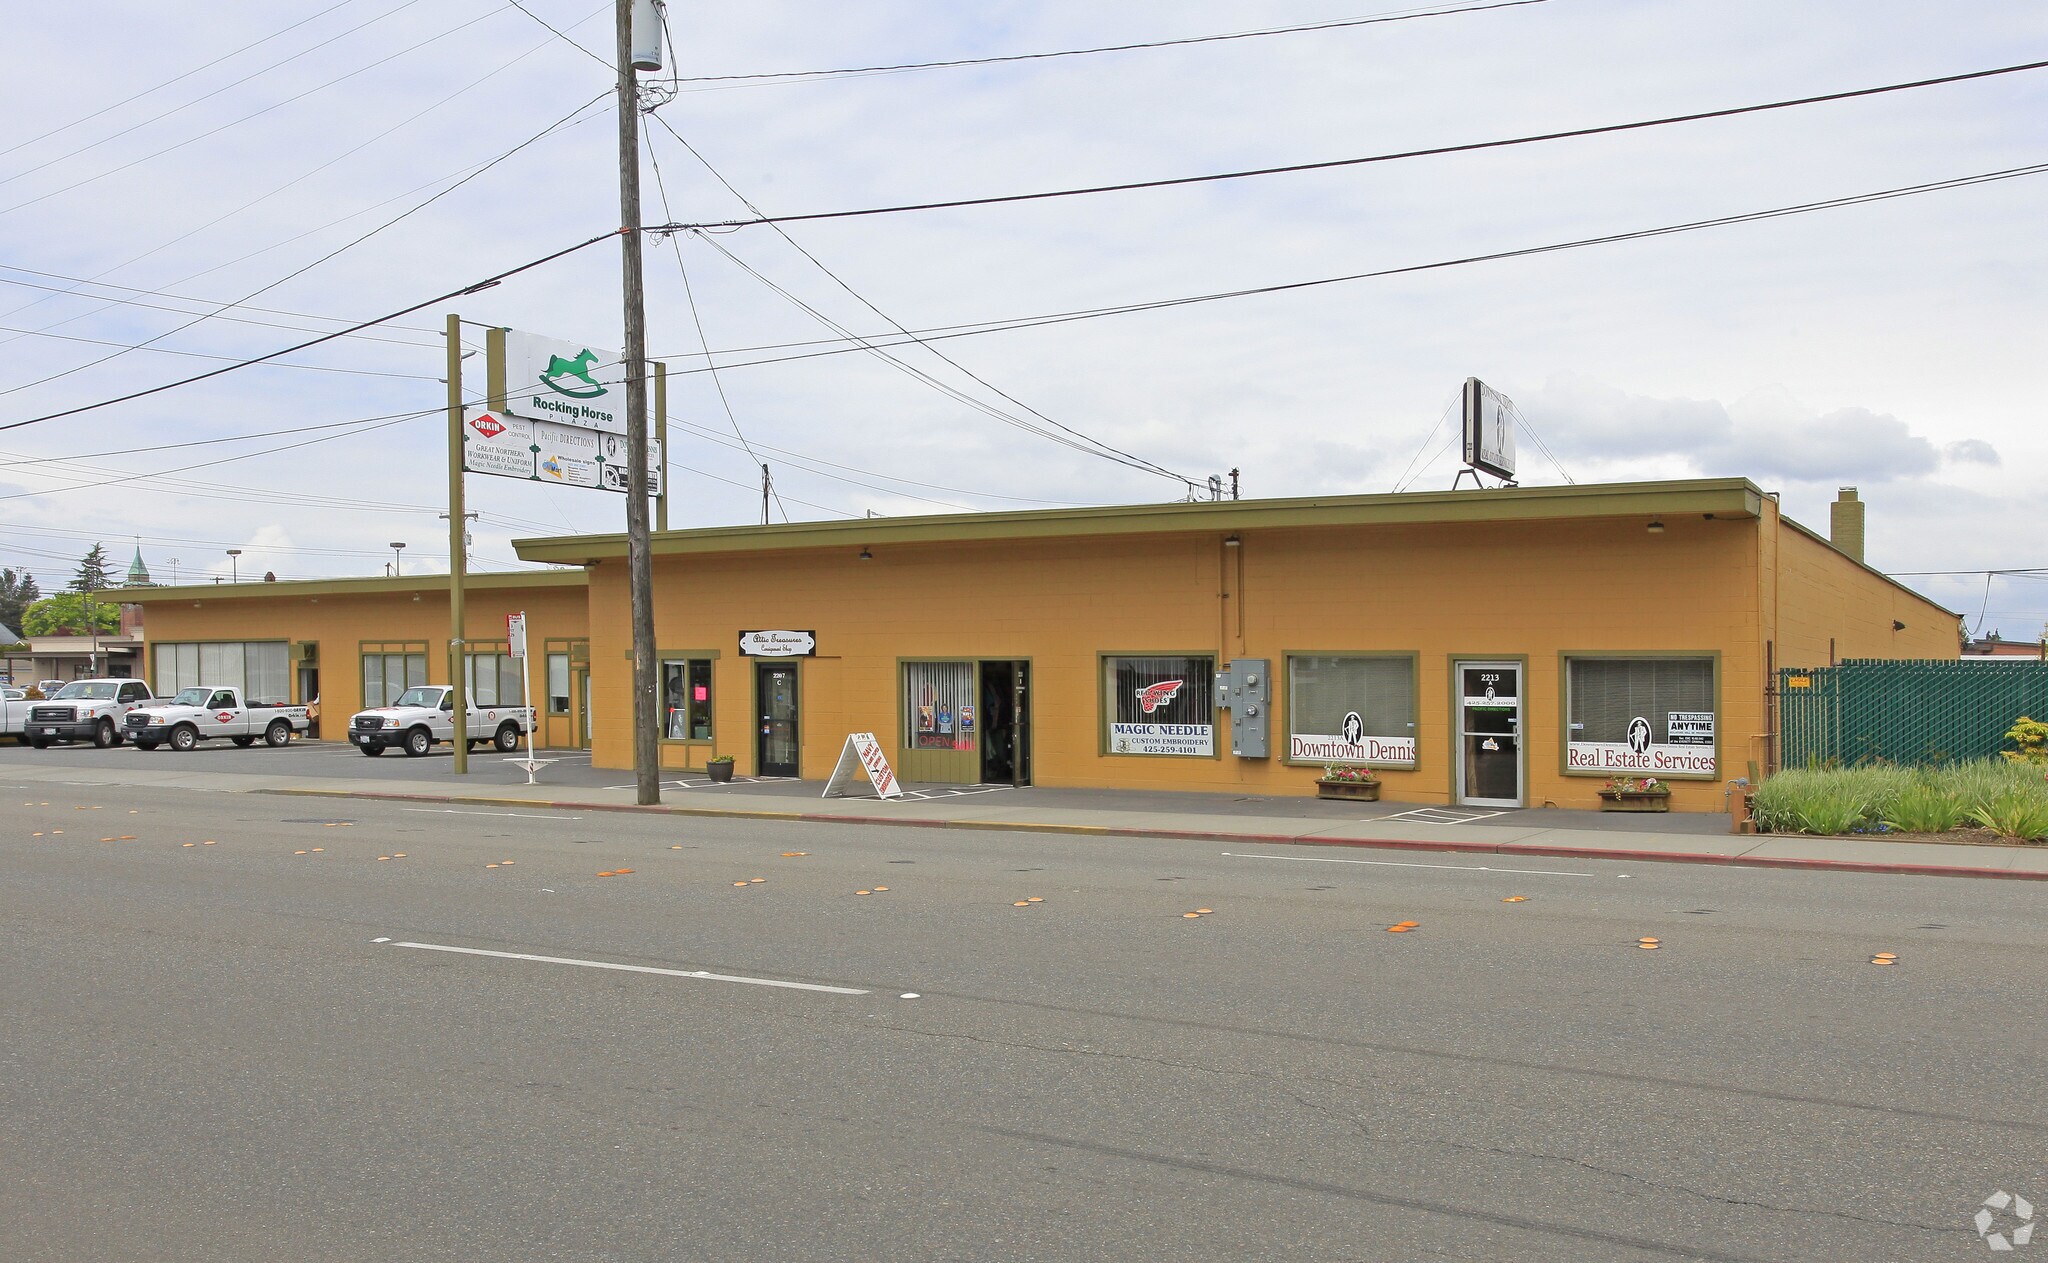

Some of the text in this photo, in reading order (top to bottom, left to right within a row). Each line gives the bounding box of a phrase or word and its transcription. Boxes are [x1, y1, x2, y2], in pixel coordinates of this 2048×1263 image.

[533, 396, 613, 422] Rocking Horse
[475, 420, 500, 432] ORKIN
[549, 413, 599, 428] PLAZA
[512, 423, 525, 431] PEST
[508, 431, 531, 440] CONTROL
[541, 430, 595, 449] Pacific DIRECTIONS
[475, 443, 525, 458] GREAT NORTHERN
[467, 450, 500, 463] WORKWEAR
[507, 456, 533, 467] UNIFORM
[557, 455, 582, 464] Wholesale
[486, 461, 503, 470] Needle
[503, 464, 531, 474] Embroidery
[752, 633, 802, 643] Attic Treasures
[782, 644, 793, 654] Shop
[1481, 674, 1500, 682] 2213
[1114, 724, 1209, 736] MAGIC NEEDLE
[1671, 722, 1712, 731] ANYTIME
[919, 735, 950, 747] OPEN
[1162, 738, 1209, 746] EMBROIDERY
[862, 742, 874, 758] NAVY
[1143, 745, 1197, 754] 425-259-4101
[1292, 737, 1416, 761] Downtown Dennis
[1568, 748, 1716, 770] Real Estate Services
